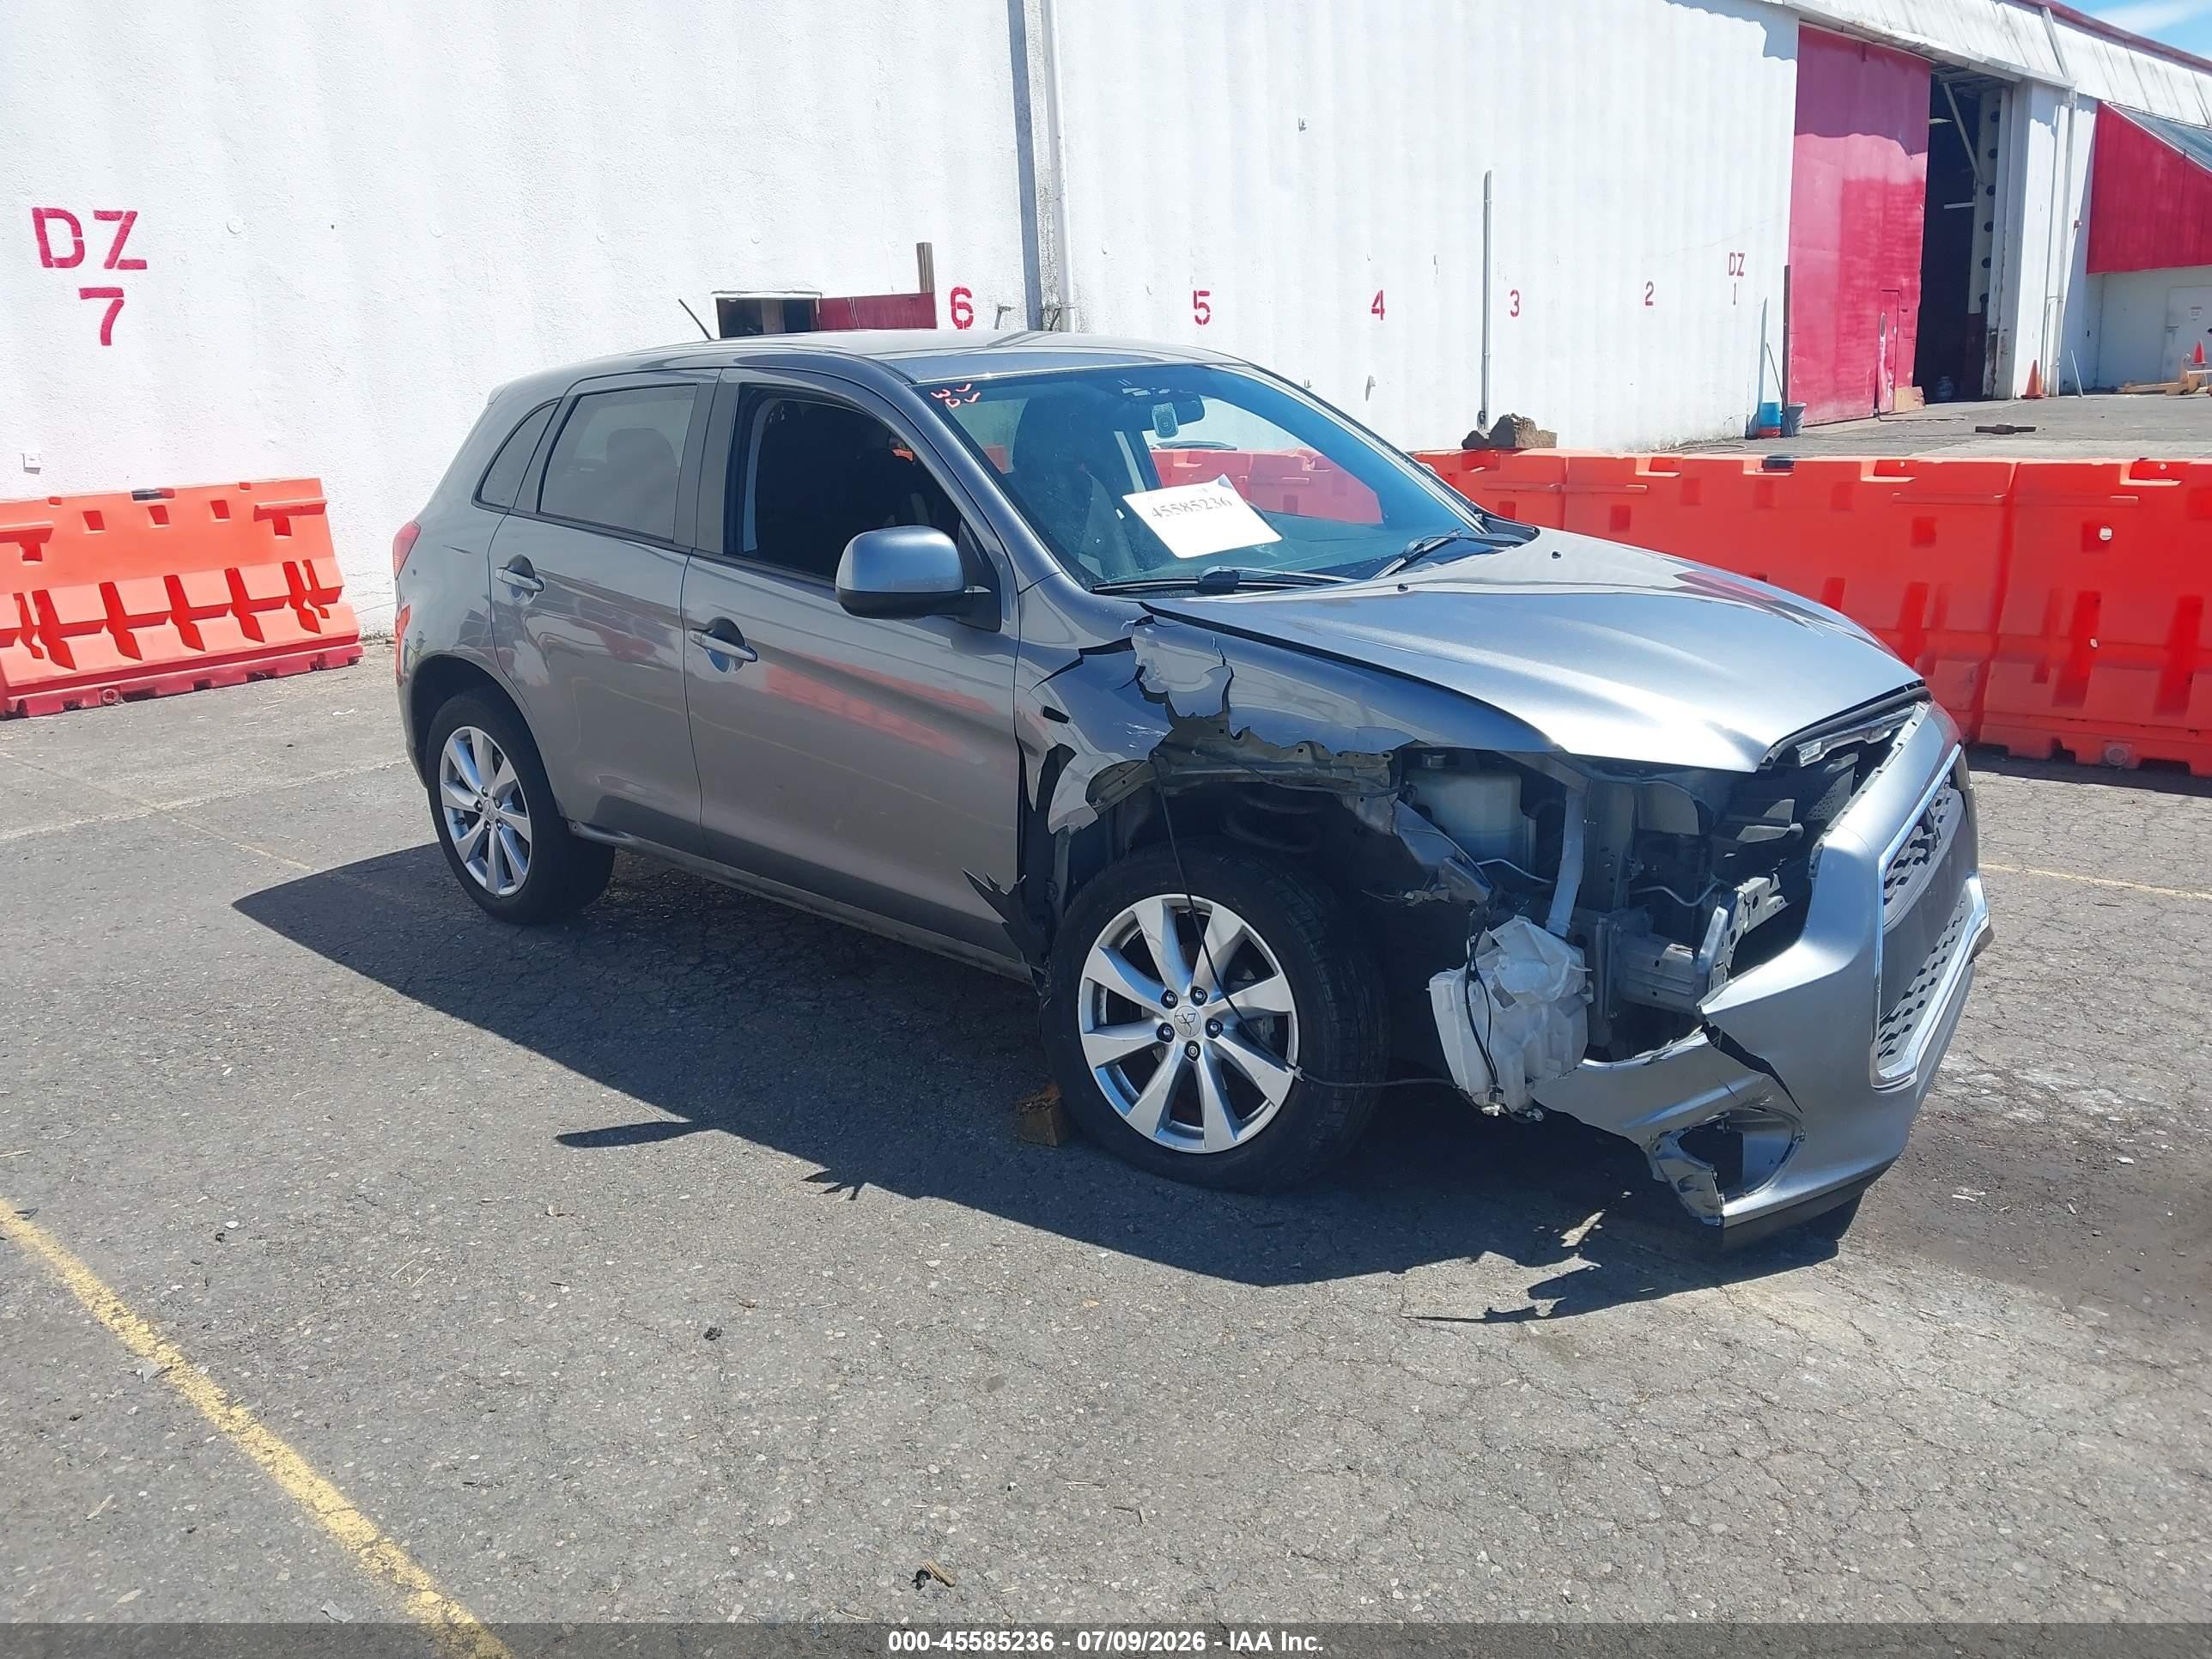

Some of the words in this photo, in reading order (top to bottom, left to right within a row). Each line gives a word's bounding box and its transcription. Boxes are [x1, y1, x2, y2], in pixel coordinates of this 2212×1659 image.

[32, 207, 148, 270] DZ
[1728, 252, 1746, 277] DZ
[950, 286, 974, 330] 6
[1192, 289, 1211, 325] 5
[1370, 289, 1386, 320] 4
[1509, 289, 1521, 318] 3
[1644, 281, 1655, 307] 2
[78, 286, 125, 346] 7
[1152, 495, 1233, 519] 45585236
